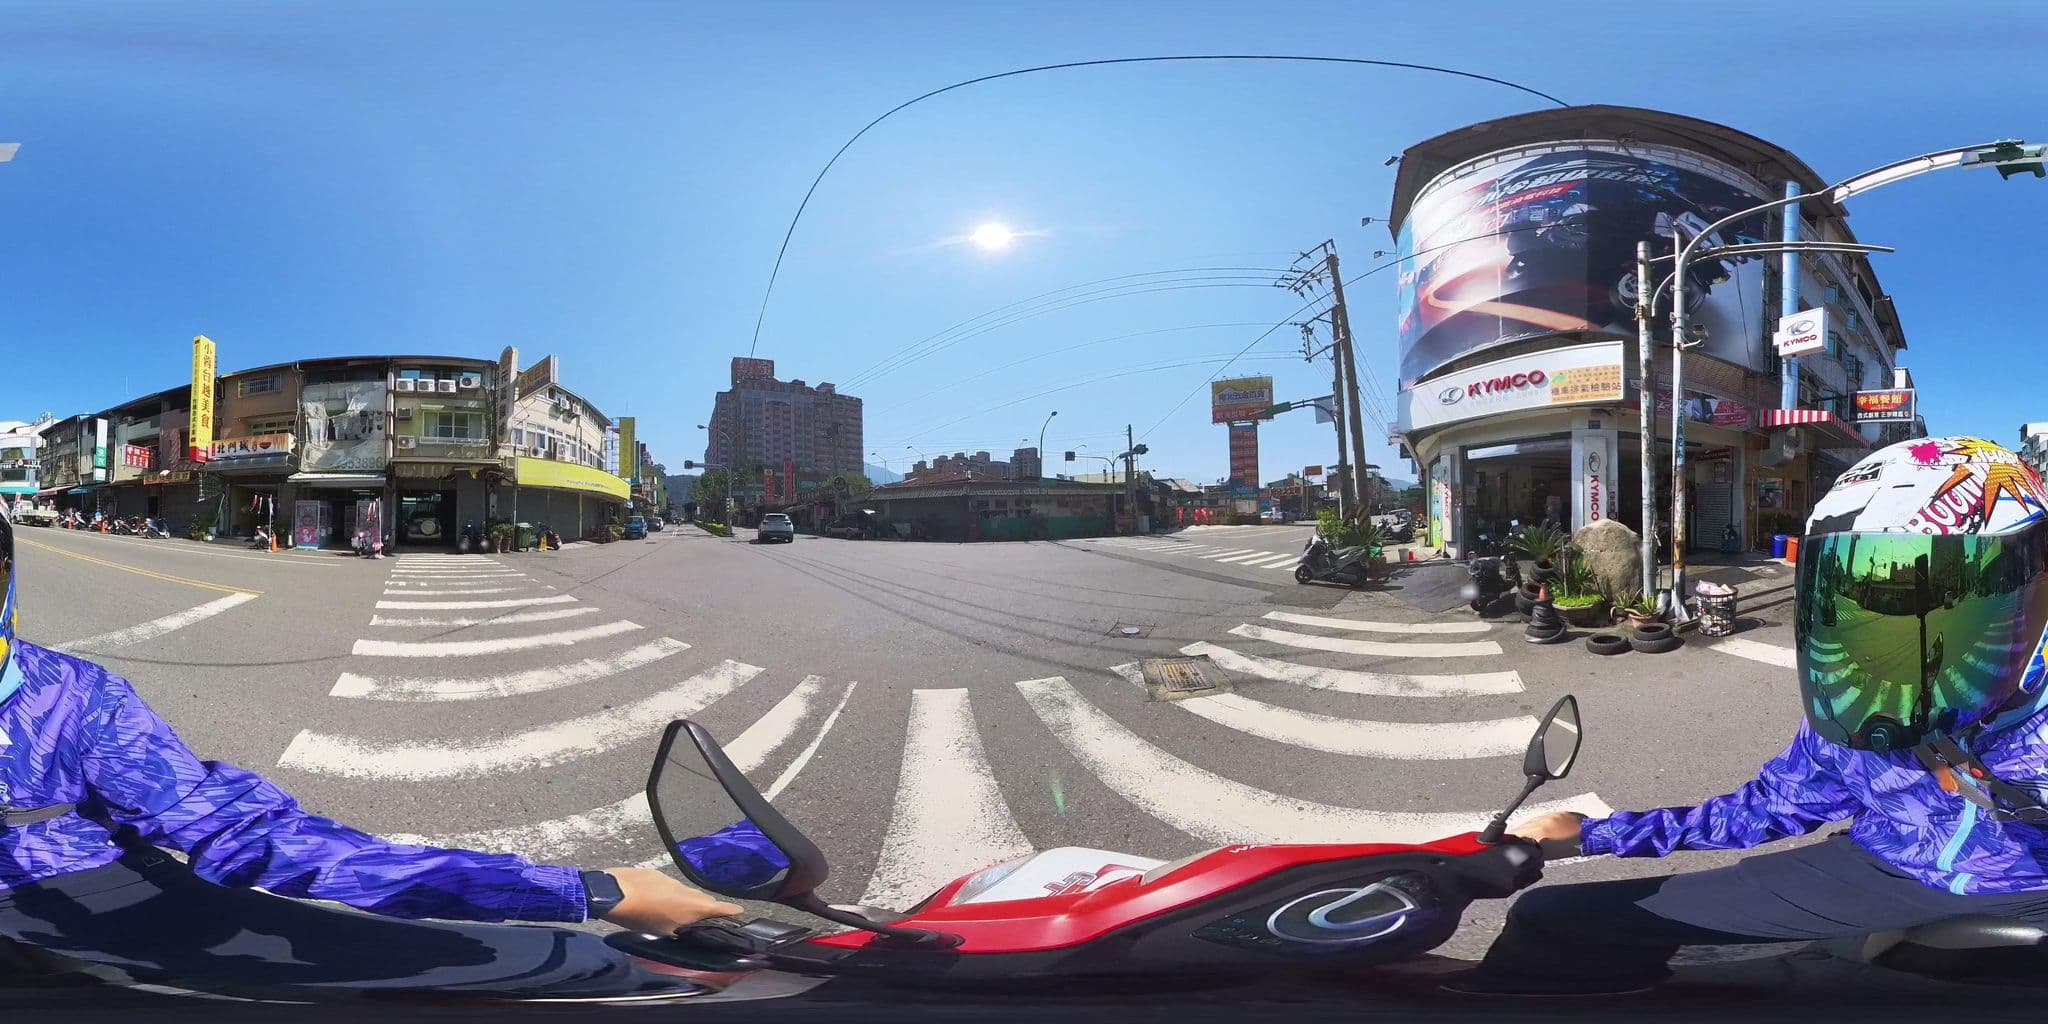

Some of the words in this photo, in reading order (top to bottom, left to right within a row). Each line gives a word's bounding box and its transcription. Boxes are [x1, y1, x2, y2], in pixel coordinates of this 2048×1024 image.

[1784, 334, 1818, 347] KYMCO
[1468, 370, 1545, 397] KYMCO
[1858, 394, 1902, 405] 幸福餐館
[1590, 475, 1600, 521] KYMCO
